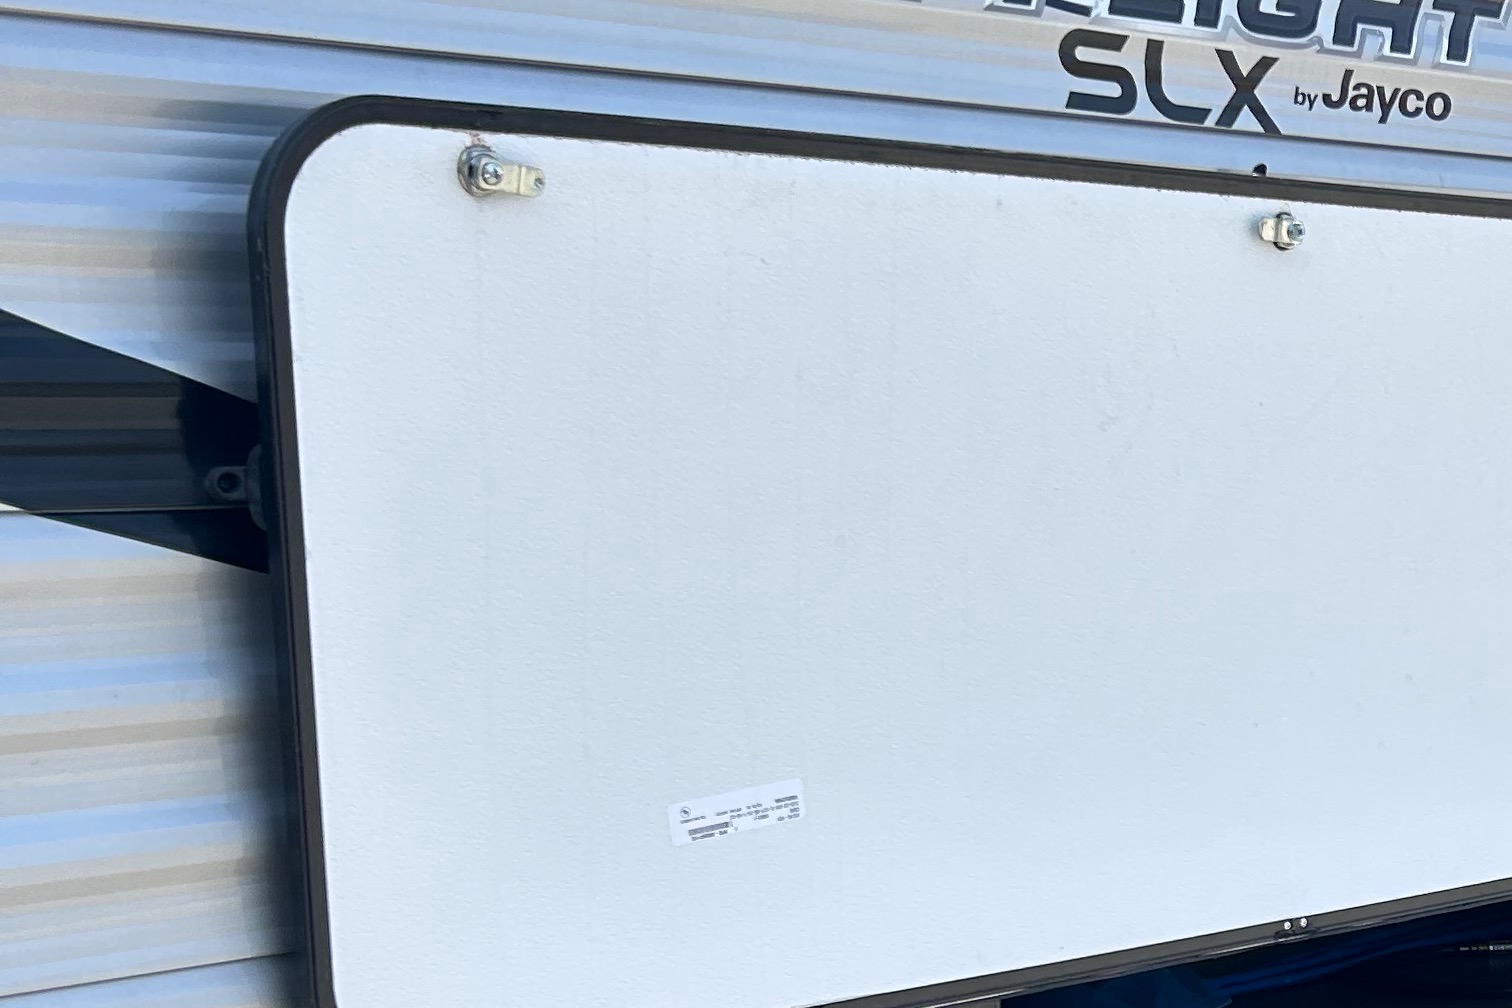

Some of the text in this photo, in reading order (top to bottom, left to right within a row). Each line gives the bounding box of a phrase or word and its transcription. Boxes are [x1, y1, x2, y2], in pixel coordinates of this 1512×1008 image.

[1058, 27, 1453, 135] SLX by Jayco
